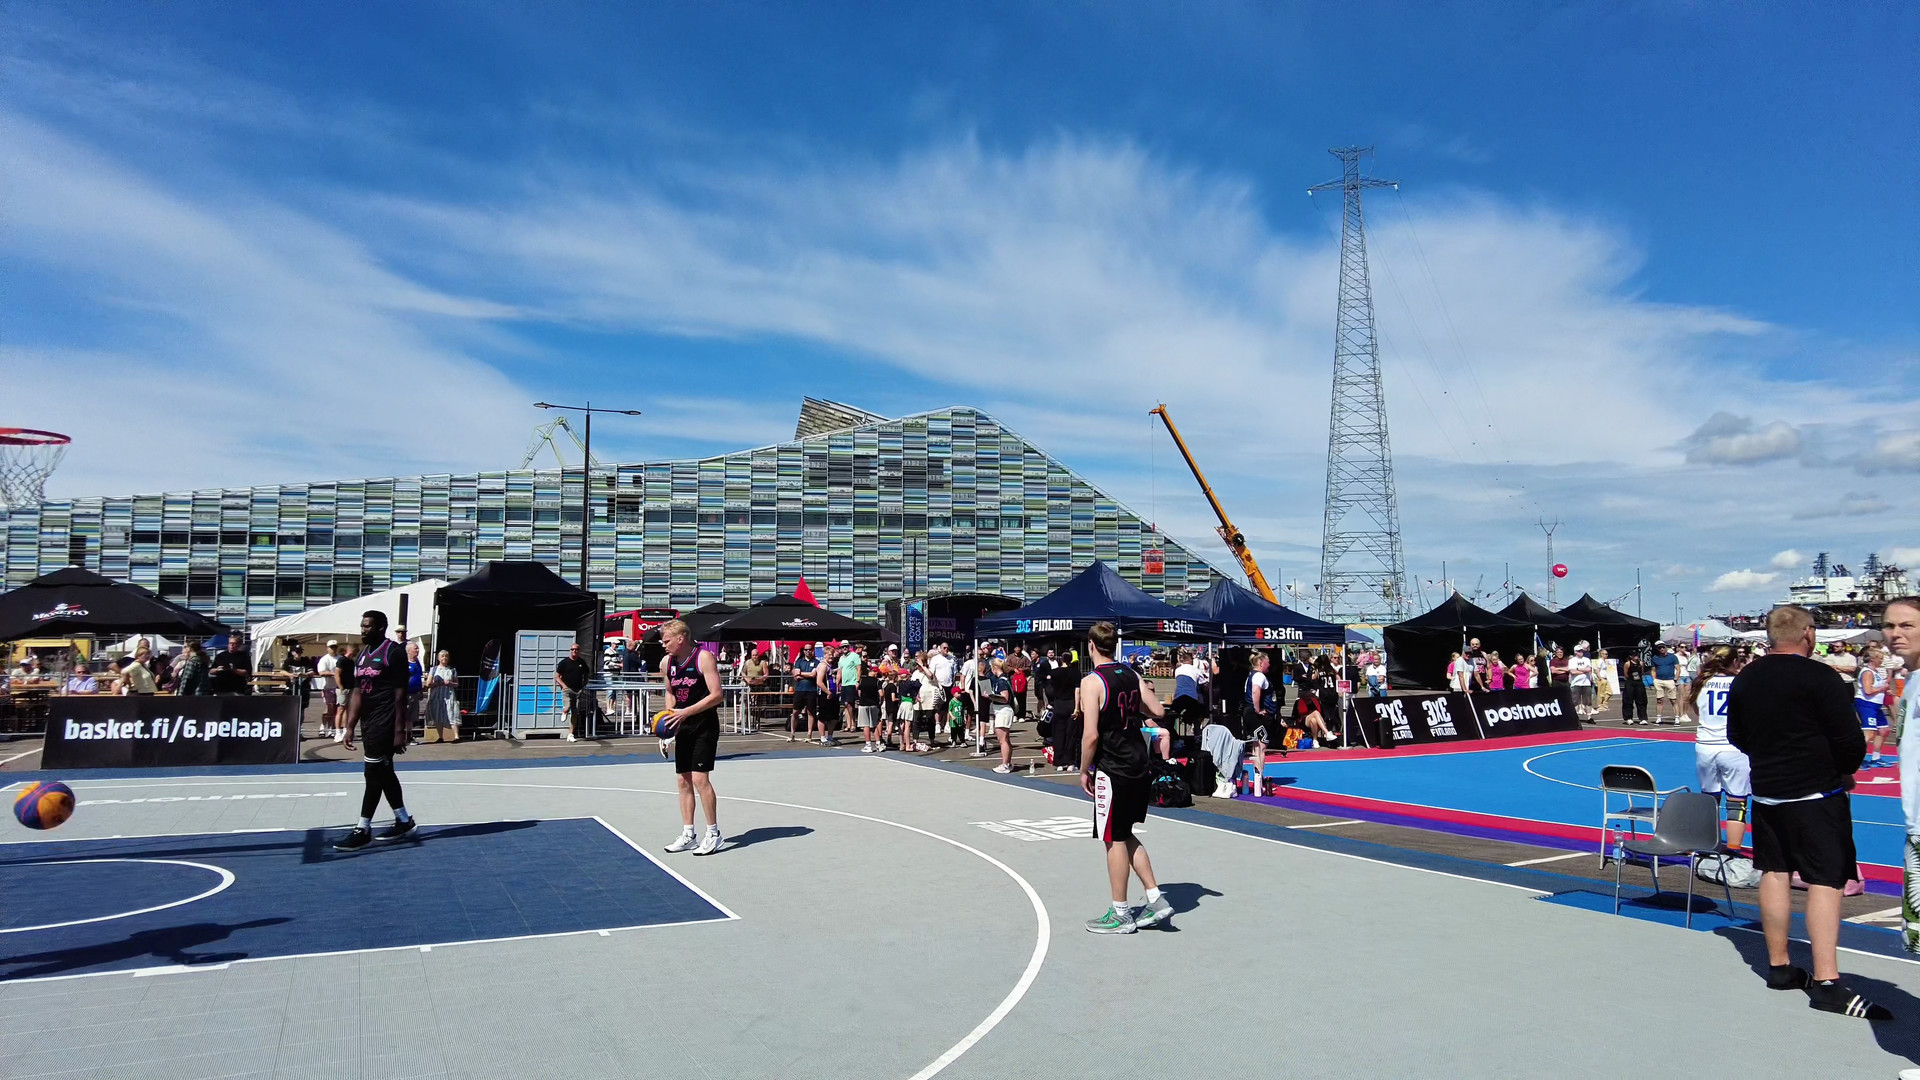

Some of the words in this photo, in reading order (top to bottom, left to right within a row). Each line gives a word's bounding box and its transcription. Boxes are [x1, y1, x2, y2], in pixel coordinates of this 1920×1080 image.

[1032, 619, 1073, 632] FINLAND
[1157, 620, 1194, 634] #3x3fin
[1255, 627, 1303, 640] #3x3fin
[1484, 699, 1562, 727] postnord
[1706, 690, 1729, 716] 12
[64, 715, 283, 743] basket.fi/6.pelaaja
[1430, 726, 1458, 738] FINLAND
[1097, 776, 1106, 817] JORDA
